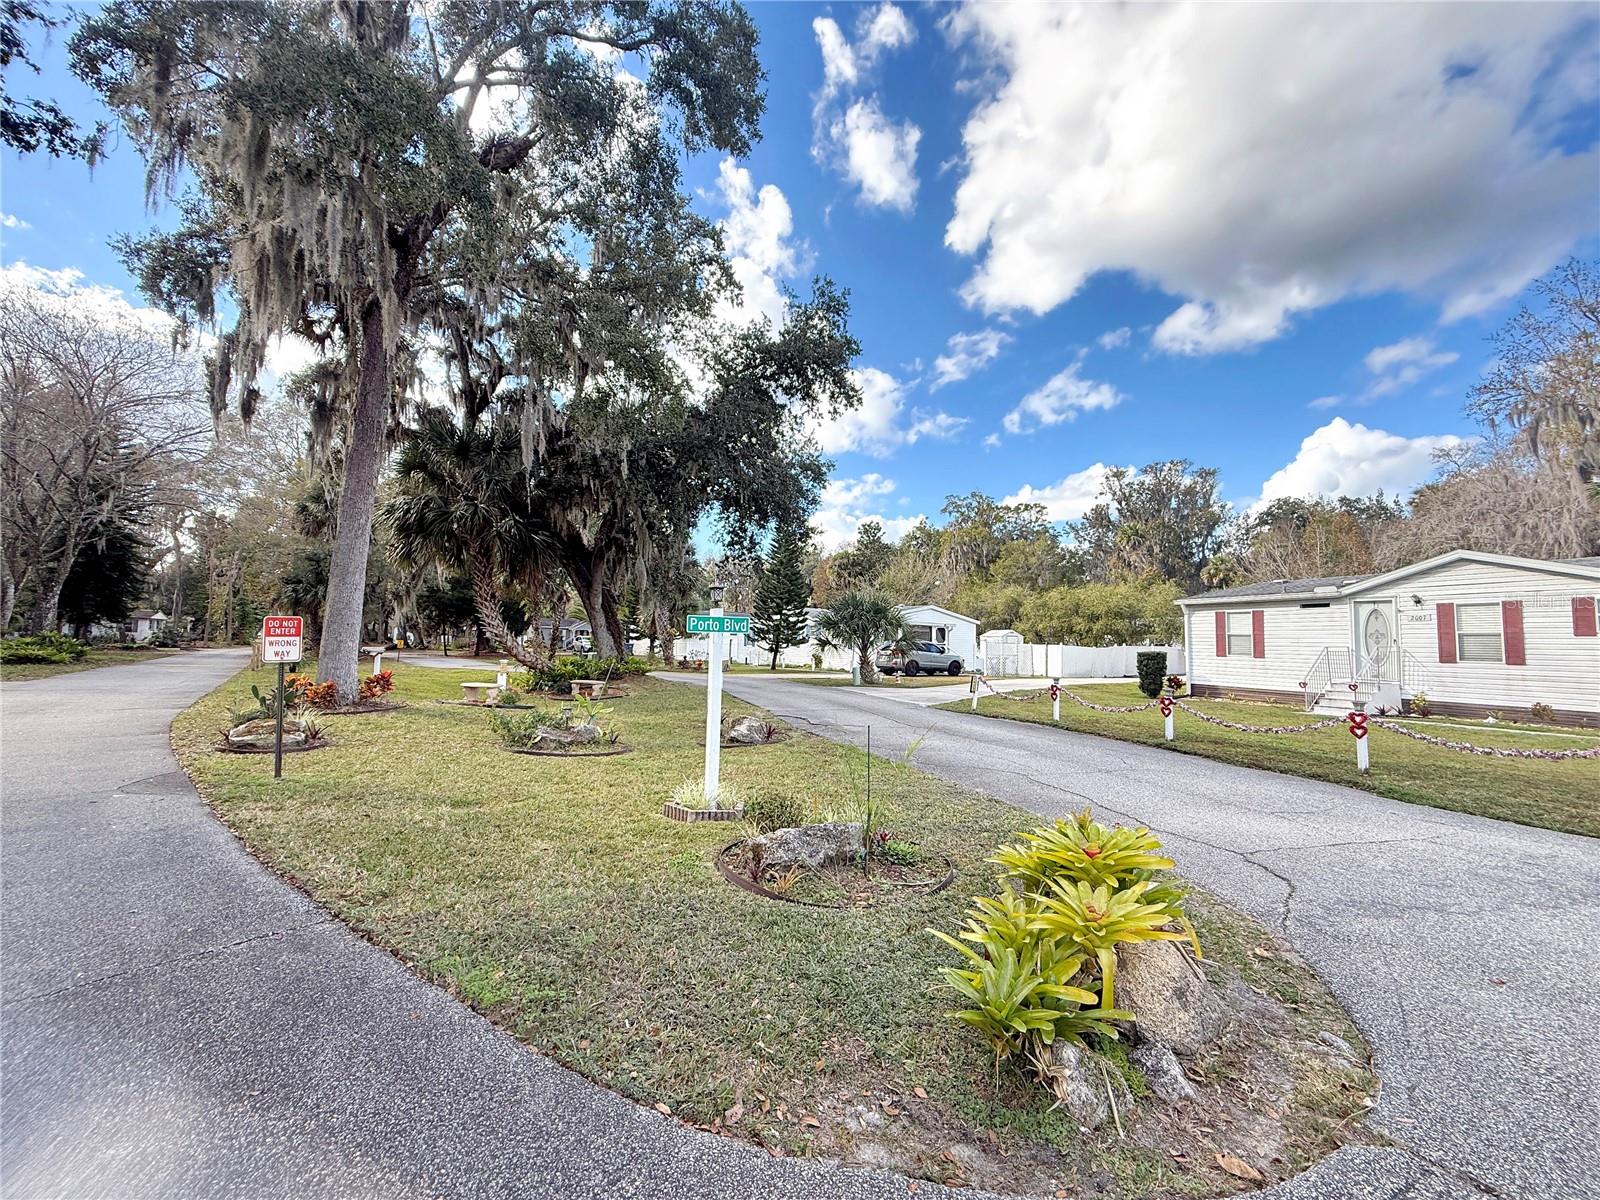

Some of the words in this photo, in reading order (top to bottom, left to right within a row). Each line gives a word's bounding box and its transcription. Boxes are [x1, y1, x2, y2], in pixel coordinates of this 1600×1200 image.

[690, 617, 719, 631] Porto
[724, 618, 747, 631] Blvd
[270, 627, 296, 635] ENTER
[268, 639, 297, 647] WRONG
